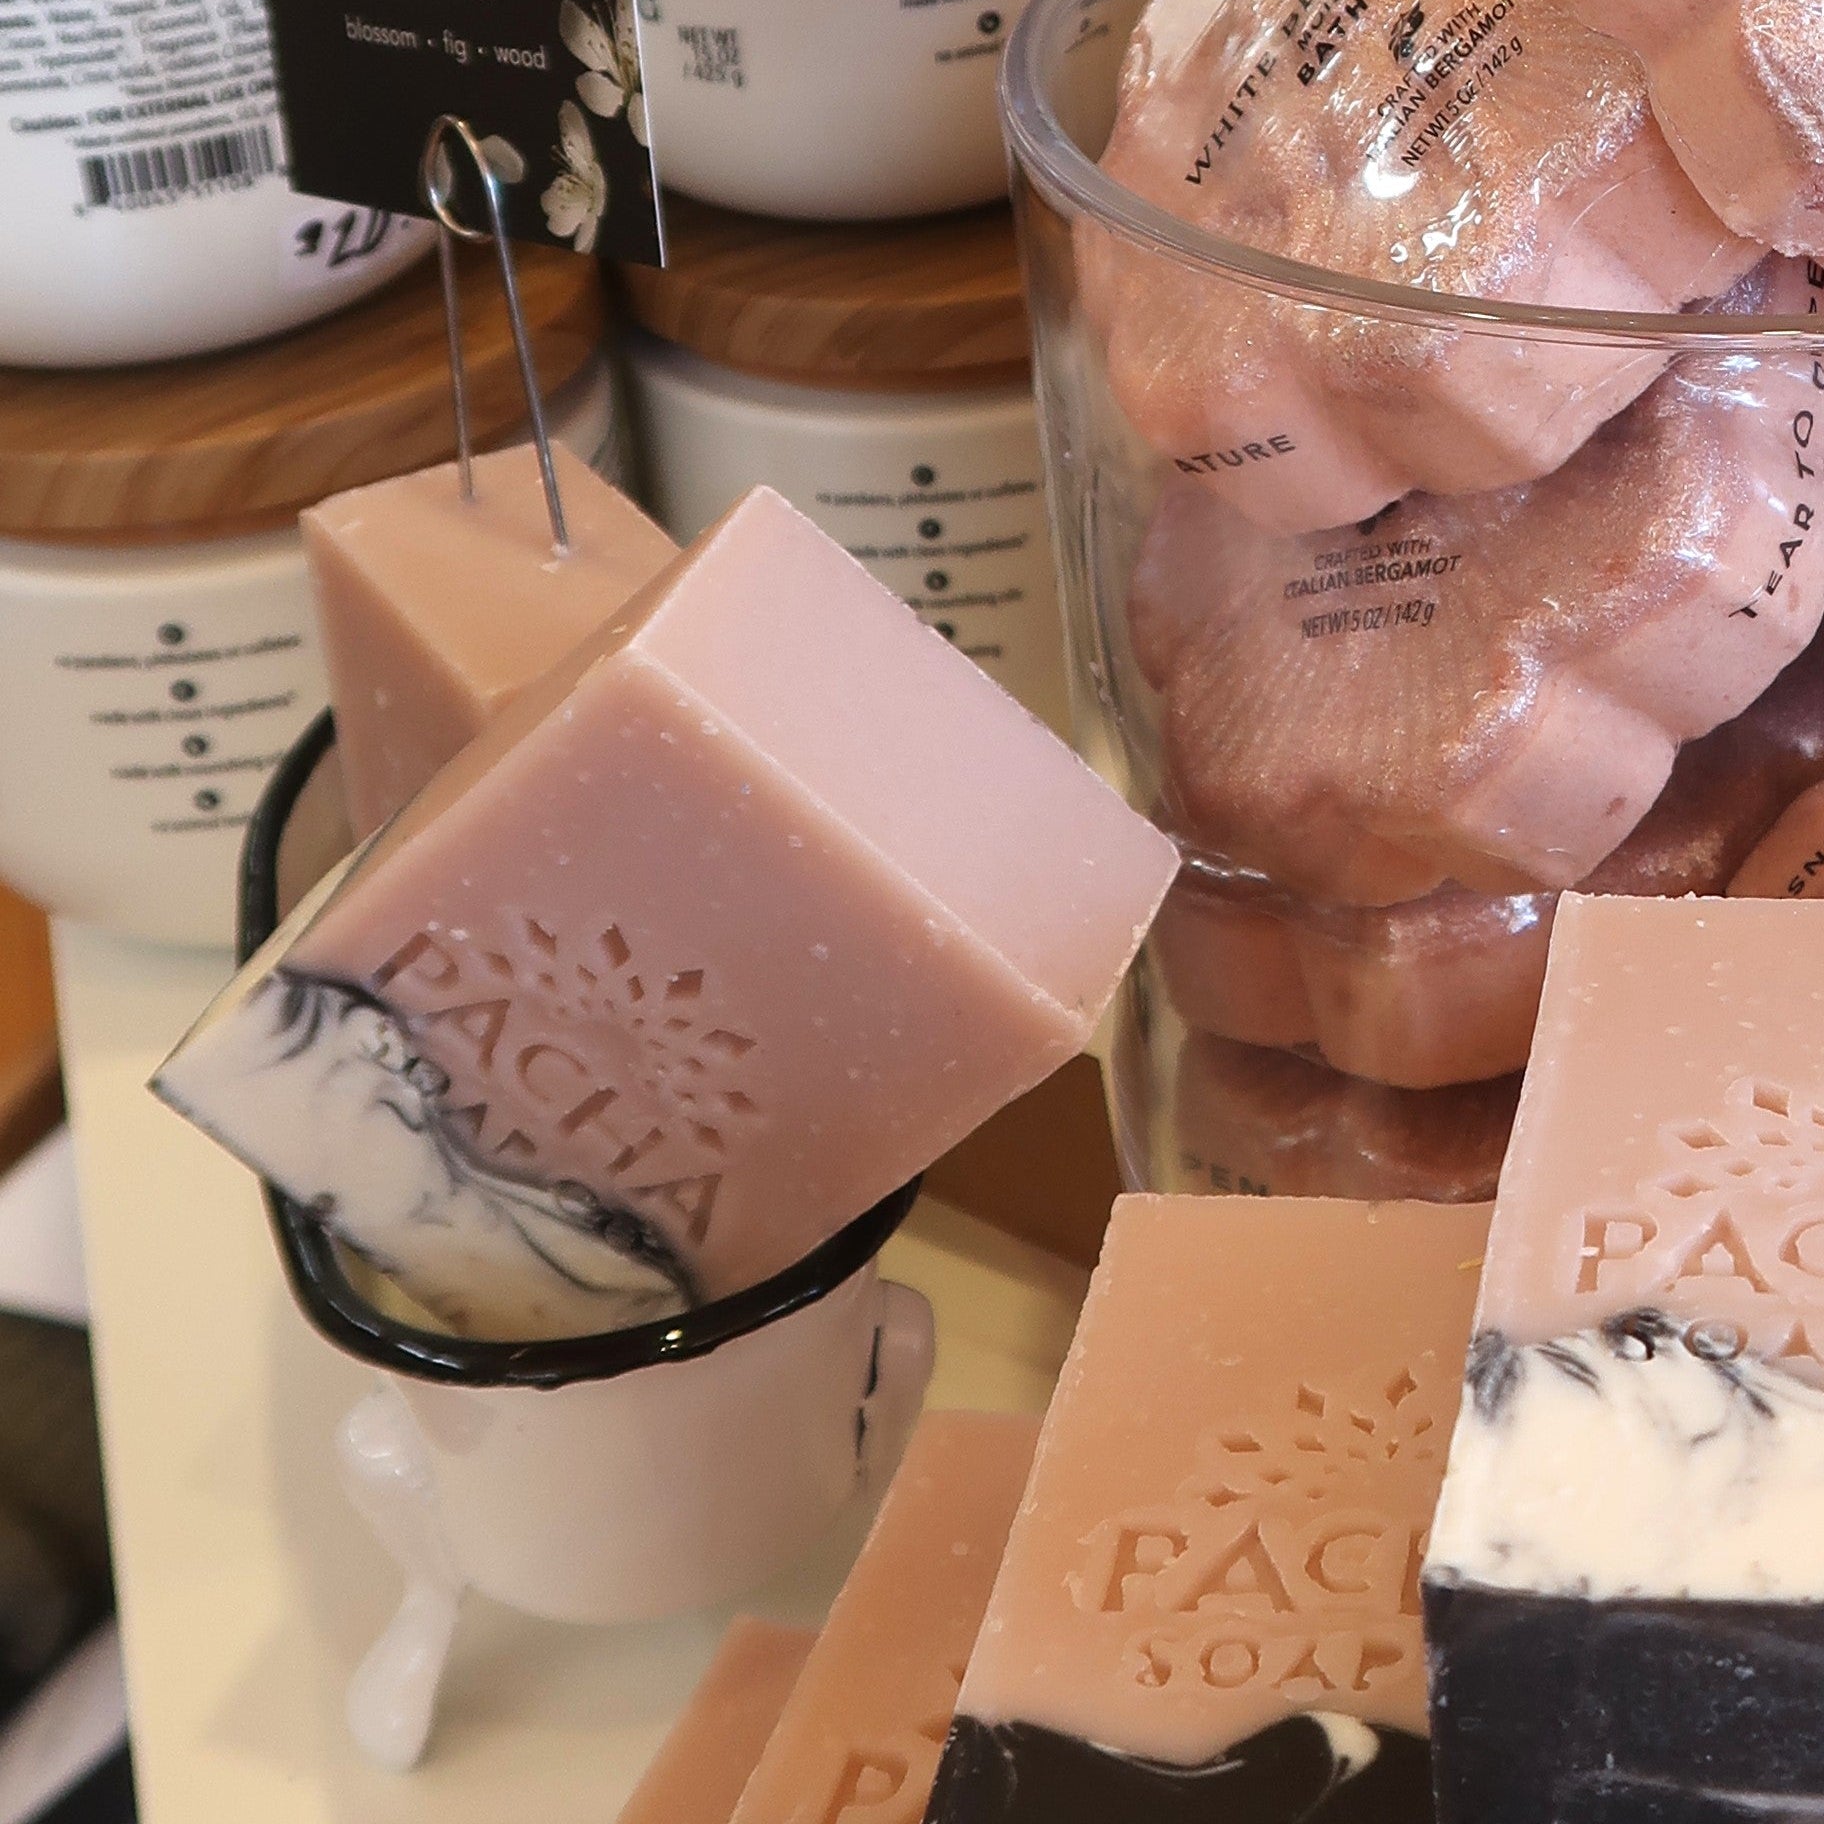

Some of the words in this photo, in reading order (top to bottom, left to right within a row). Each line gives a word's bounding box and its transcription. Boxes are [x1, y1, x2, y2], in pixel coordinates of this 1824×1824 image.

[344, 14, 418, 49] blossom
[442, 28, 468, 63] fig
[493, 44, 547, 70] wood
[1437, 2, 1482, 44] WITH
[1184, 52, 1280, 187] WHITE
[1401, 134, 1431, 167] NET
[1424, 109, 1450, 139] WT
[1446, 100, 1460, 116] 5
[1482, 45, 1512, 77] 142
[1510, 35, 1524, 55] g
[1173, 434, 1297, 476] ATURE
[1728, 502, 1815, 619] TEAR
[1793, 409, 1816, 480] TO
[1283, 570, 1350, 600] ITALIAN
[1355, 554, 1462, 586] BERGAMOT
[1314, 544, 1381, 571] CRAFTED
[1387, 538, 1433, 557] WITH
[1301, 614, 1328, 640] NET
[1326, 607, 1351, 636] WT
[1350, 608, 1361, 633] 5
[1362, 605, 1384, 631] OZ
[1394, 599, 1422, 626] 142
[1421, 602, 1436, 627] g
[370, 930, 723, 1247] PACHA
[1100, 1523, 1424, 1614] PAC
[1134, 1639, 1404, 1692] SOAP
